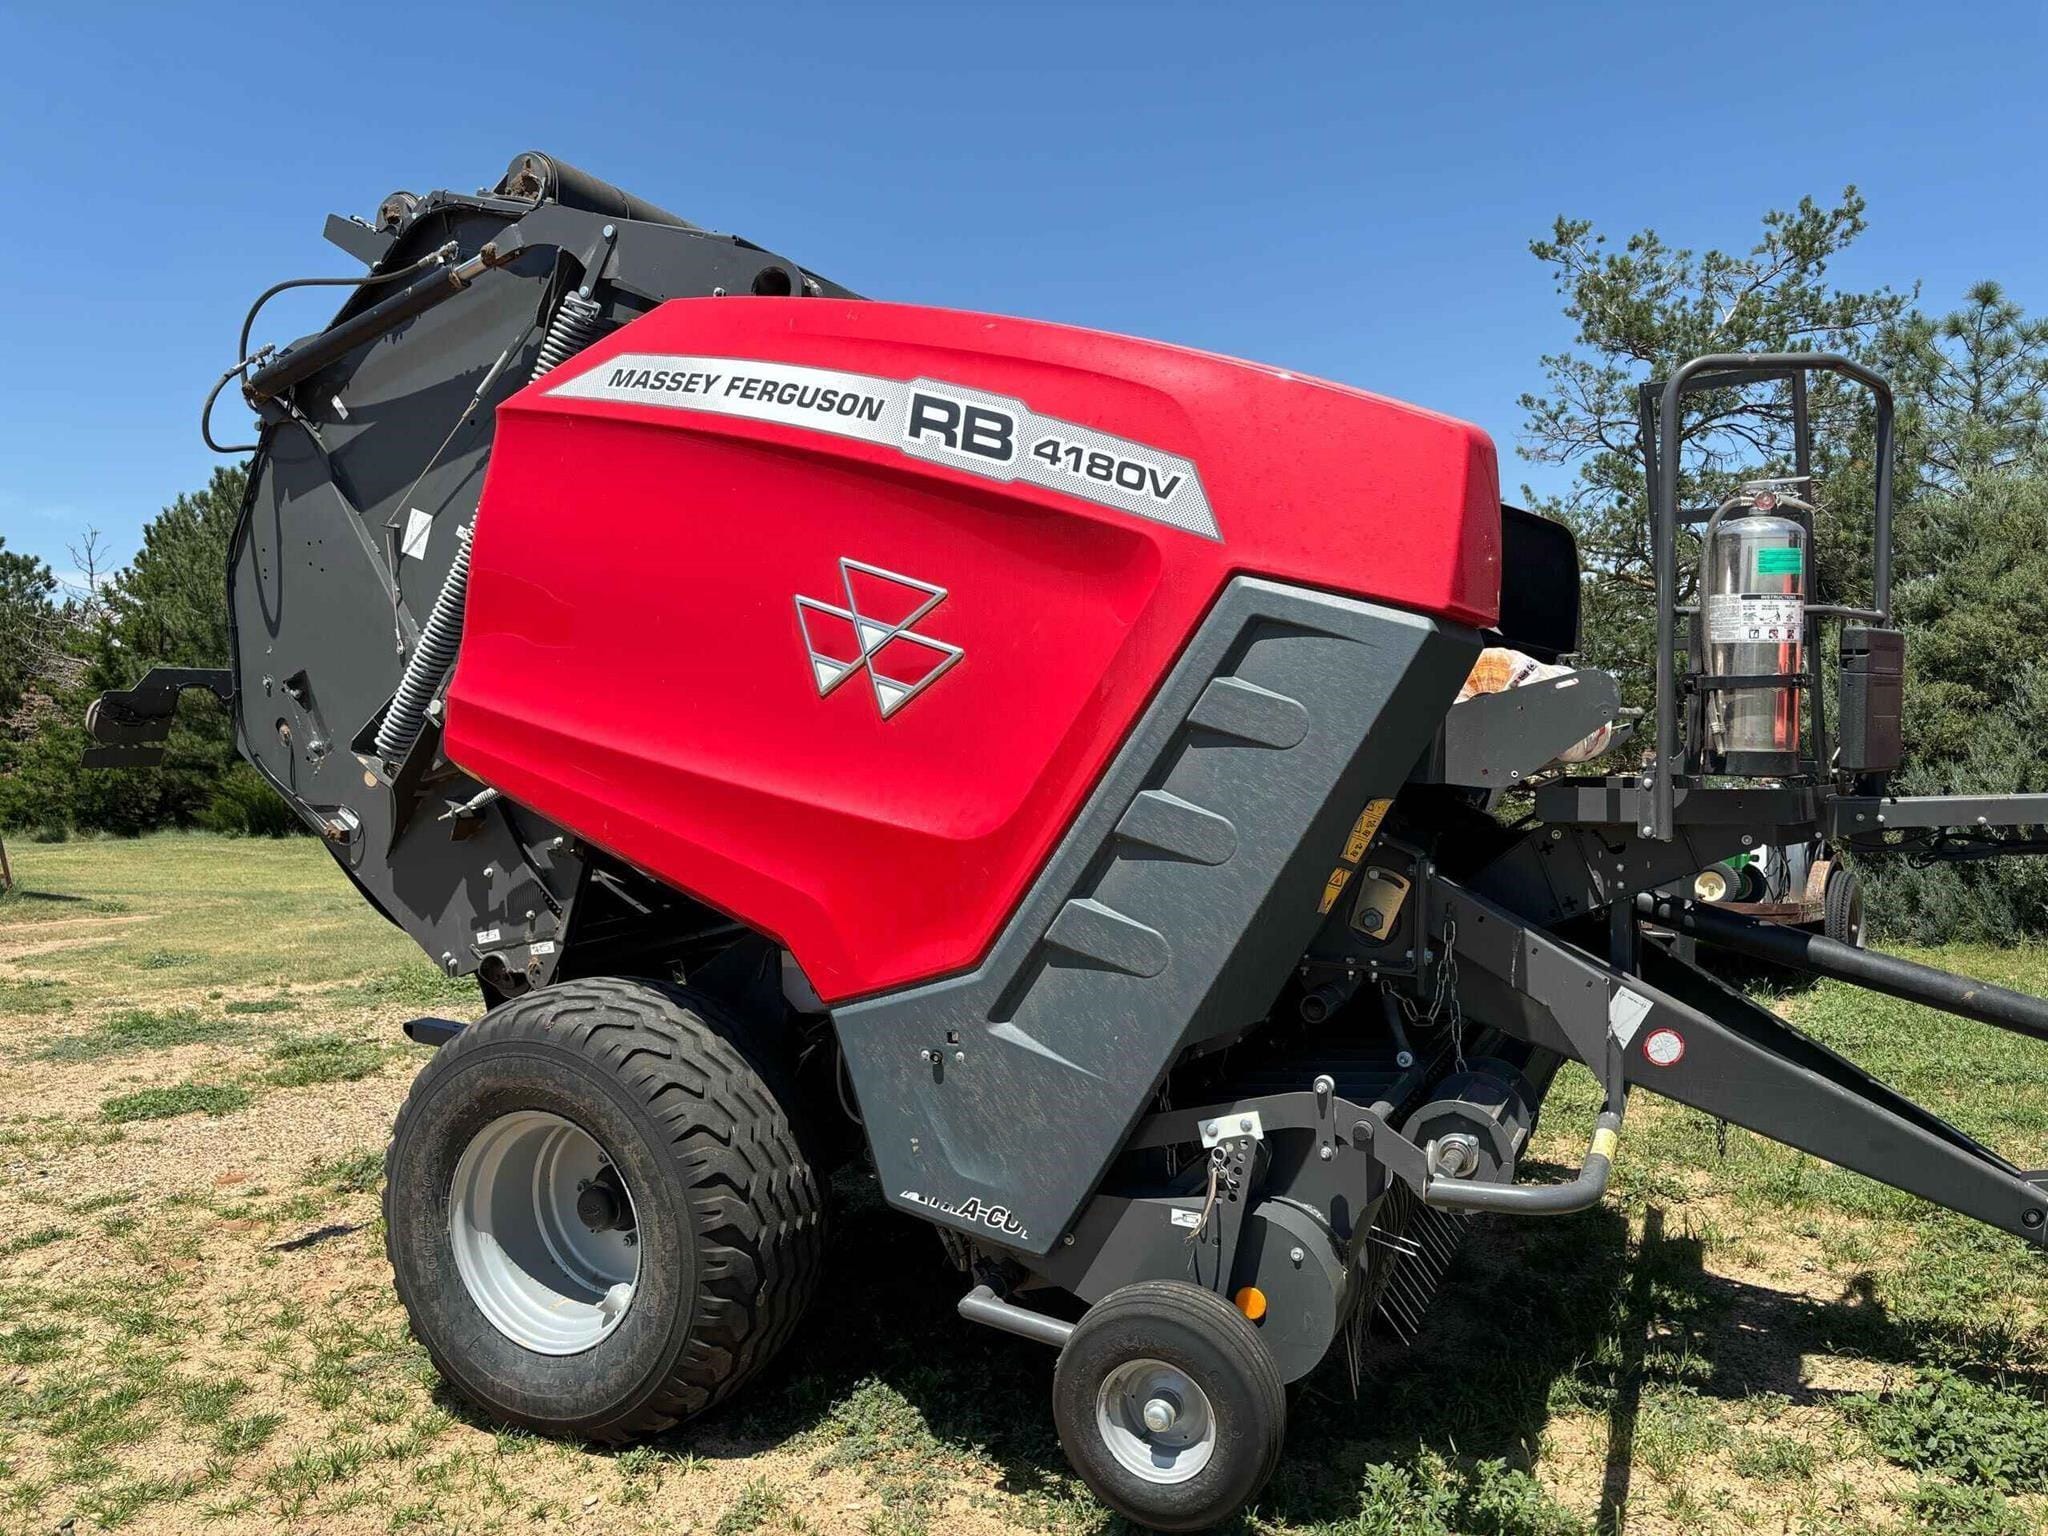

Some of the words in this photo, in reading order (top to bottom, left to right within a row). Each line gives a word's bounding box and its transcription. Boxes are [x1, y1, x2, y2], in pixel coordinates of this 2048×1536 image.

[607, 368, 721, 395] MASSEY
[723, 376, 886, 422] FERGUSON
[907, 392, 1014, 461] RB
[1032, 438, 1182, 500] 4180V
